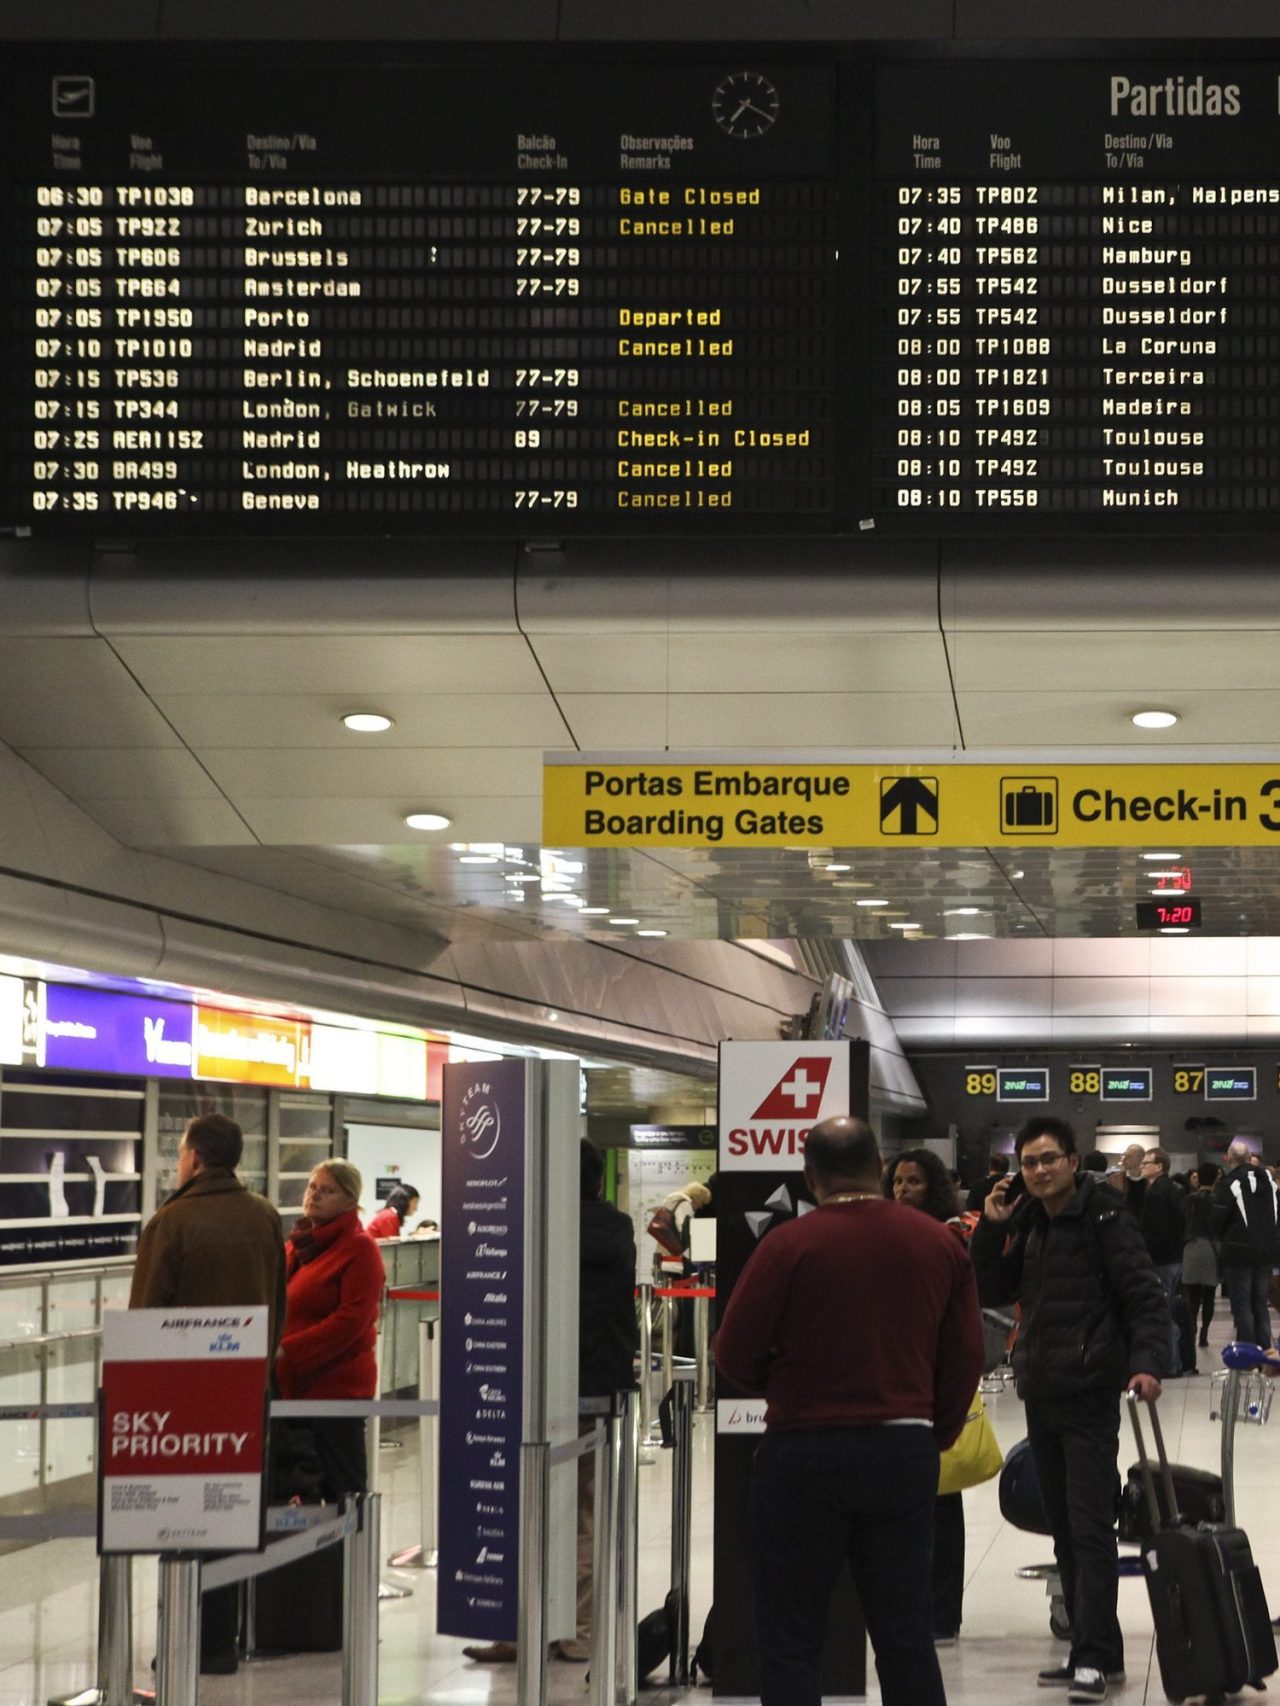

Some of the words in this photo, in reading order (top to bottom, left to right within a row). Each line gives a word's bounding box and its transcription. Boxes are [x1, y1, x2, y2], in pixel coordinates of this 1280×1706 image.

[1110, 76, 1241, 117] Partidas
[517, 134, 556, 150] Balcão
[912, 135, 940, 150] Hora
[990, 134, 1011, 149] Voo
[620, 154, 671, 169] Remarks
[914, 154, 941, 169] Time
[990, 153, 1021, 170] Flight
[245, 187, 362, 206] Barcelona
[620, 188, 670, 205] Gate
[684, 188, 760, 205] Closed
[898, 187, 961, 205] 07:35
[976, 186, 1038, 204] TP802
[245, 217, 323, 237] Zurich
[619, 218, 734, 235] Cancelled
[898, 217, 961, 235] 07:40
[975, 216, 1038, 235] TP486
[1102, 216, 1153, 234] Nice
[244, 247, 348, 267] Brussels
[898, 247, 961, 265] 07:40
[975, 247, 1038, 265] TP562
[1102, 247, 1191, 266] Hamburg
[244, 278, 361, 297] Amsterdam
[898, 278, 961, 295] 07:55
[975, 277, 1038, 295] TP542
[1102, 276, 1227, 294] Dusseldorf
[244, 308, 309, 327] Porto
[619, 308, 721, 328] Departed
[898, 308, 961, 326] 07:55
[975, 307, 1038, 325] TP542
[1102, 307, 1227, 325] Dusseldorf
[244, 339, 321, 358] Madrid
[618, 339, 733, 356] Cancelled
[898, 338, 961, 356] 08:00
[975, 338, 1050, 355] TP1088
[1102, 337, 1127, 355] La
[1141, 337, 1216, 355] Coruna
[347, 369, 489, 388] Schoenefeld
[897, 368, 961, 386] 08:00
[975, 368, 1048, 386] TP1821
[1103, 368, 1204, 385] Terceira
[348, 401, 436, 417] Gatwick
[618, 399, 732, 417] Cancelled
[898, 399, 961, 416] 08:05
[975, 398, 1050, 416] TP1609
[1102, 398, 1191, 416] Madeira
[242, 430, 320, 449] Madrid
[617, 430, 720, 447] Check-in
[734, 429, 810, 447] Closed
[897, 429, 961, 447] 08:10
[975, 429, 1037, 446] TP492
[1103, 428, 1204, 446] Toulouse
[346, 460, 450, 479] Heathrow
[618, 460, 732, 477] Cancelled
[897, 459, 961, 477] 08:10
[975, 459, 1037, 476] TP492
[1102, 458, 1204, 476] Toulouse
[242, 491, 320, 510] Geneva
[618, 490, 732, 507] Cancelled
[897, 489, 961, 507] 08:10
[975, 489, 1038, 507] TP558
[1102, 489, 1178, 507] Munich
[585, 771, 683, 797] Portas
[694, 771, 850, 802] Embarque
[1072, 789, 1247, 822] Check-in
[584, 810, 724, 841] Boarding
[735, 809, 824, 835] Gates
[1157, 906, 1193, 923] 7:20
[966, 1073, 996, 1095] 89
[1070, 1072, 1100, 1093] 88
[1174, 1071, 1204, 1092] 87
[209, 1341, 240, 1352] KLM
[112, 1411, 171, 1433] SKY
[111, 1432, 249, 1457] PRIORITY
